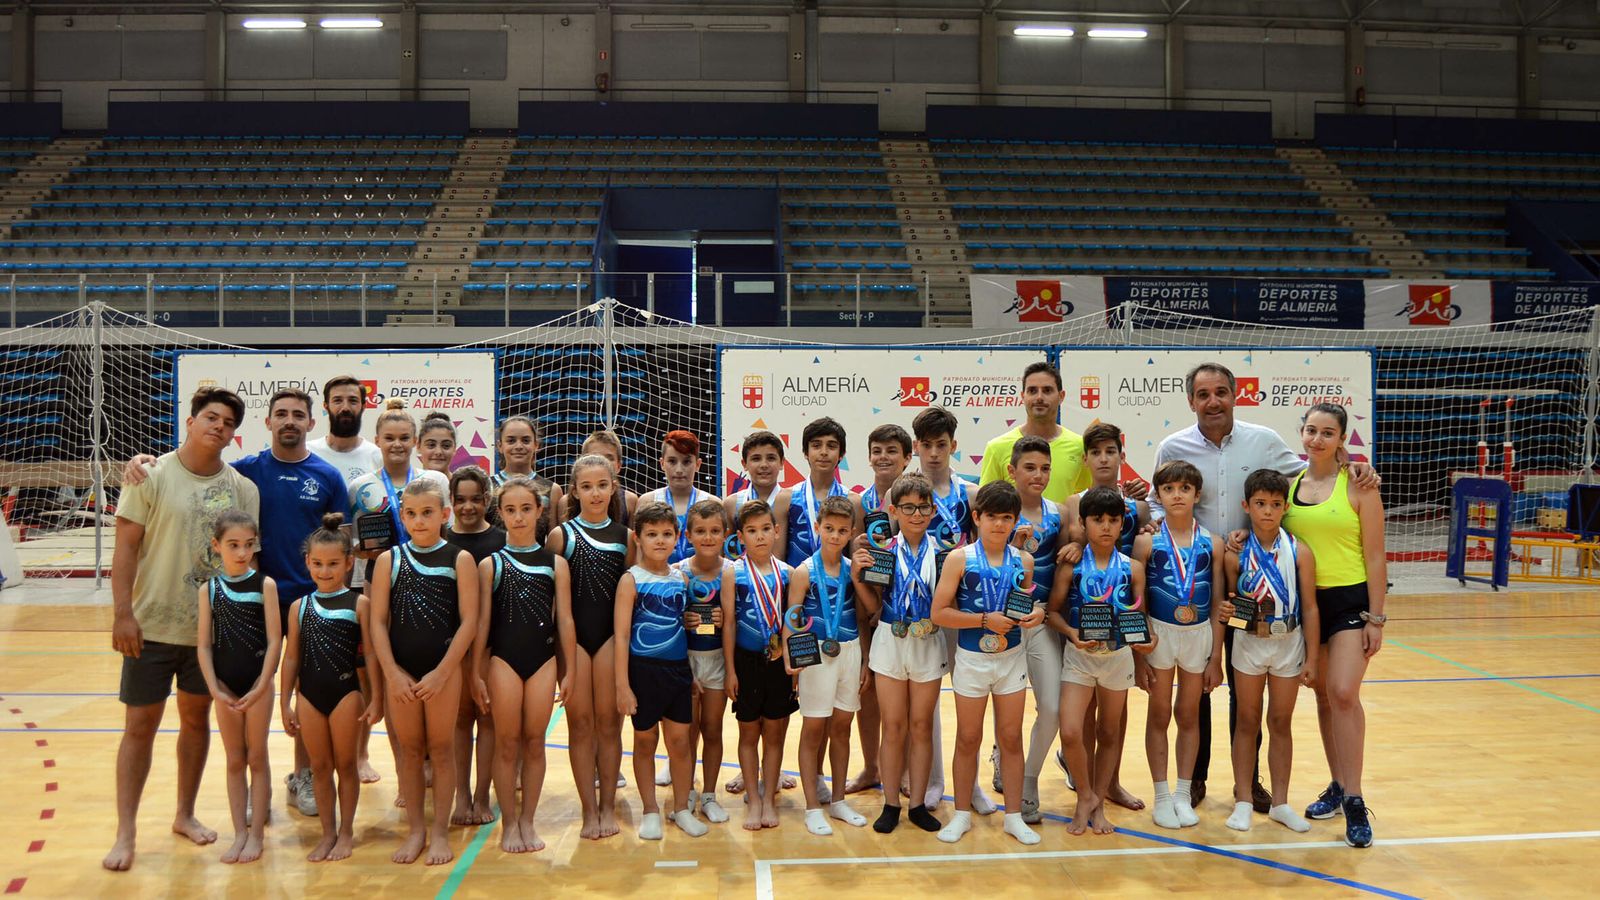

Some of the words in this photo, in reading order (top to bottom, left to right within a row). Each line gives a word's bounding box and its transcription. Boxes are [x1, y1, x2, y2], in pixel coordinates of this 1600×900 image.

[1130, 287, 1209, 298] DEPORTES
[1259, 288, 1338, 301] DEPORTES
[1515, 292, 1589, 304] DEPORTES
[1153, 300, 1210, 310] ALMERIA
[1259, 301, 1277, 311] DE
[1280, 302, 1338, 313] ALMERIA
[1515, 304, 1532, 314] DE
[782, 373, 870, 392] ALMERÍA
[1118, 377, 1184, 393] ALMER
[391, 387, 465, 397] DEPORTES
[943, 385, 1017, 395] DEPORTES
[1272, 385, 1343, 395] DEPORTES
[413, 399, 475, 408] ALMERIA
[781, 395, 827, 406] CIUDAD
[943, 397, 962, 407] DE
[1118, 396, 1161, 406] CIUDAD
[1272, 397, 1290, 407] DE
